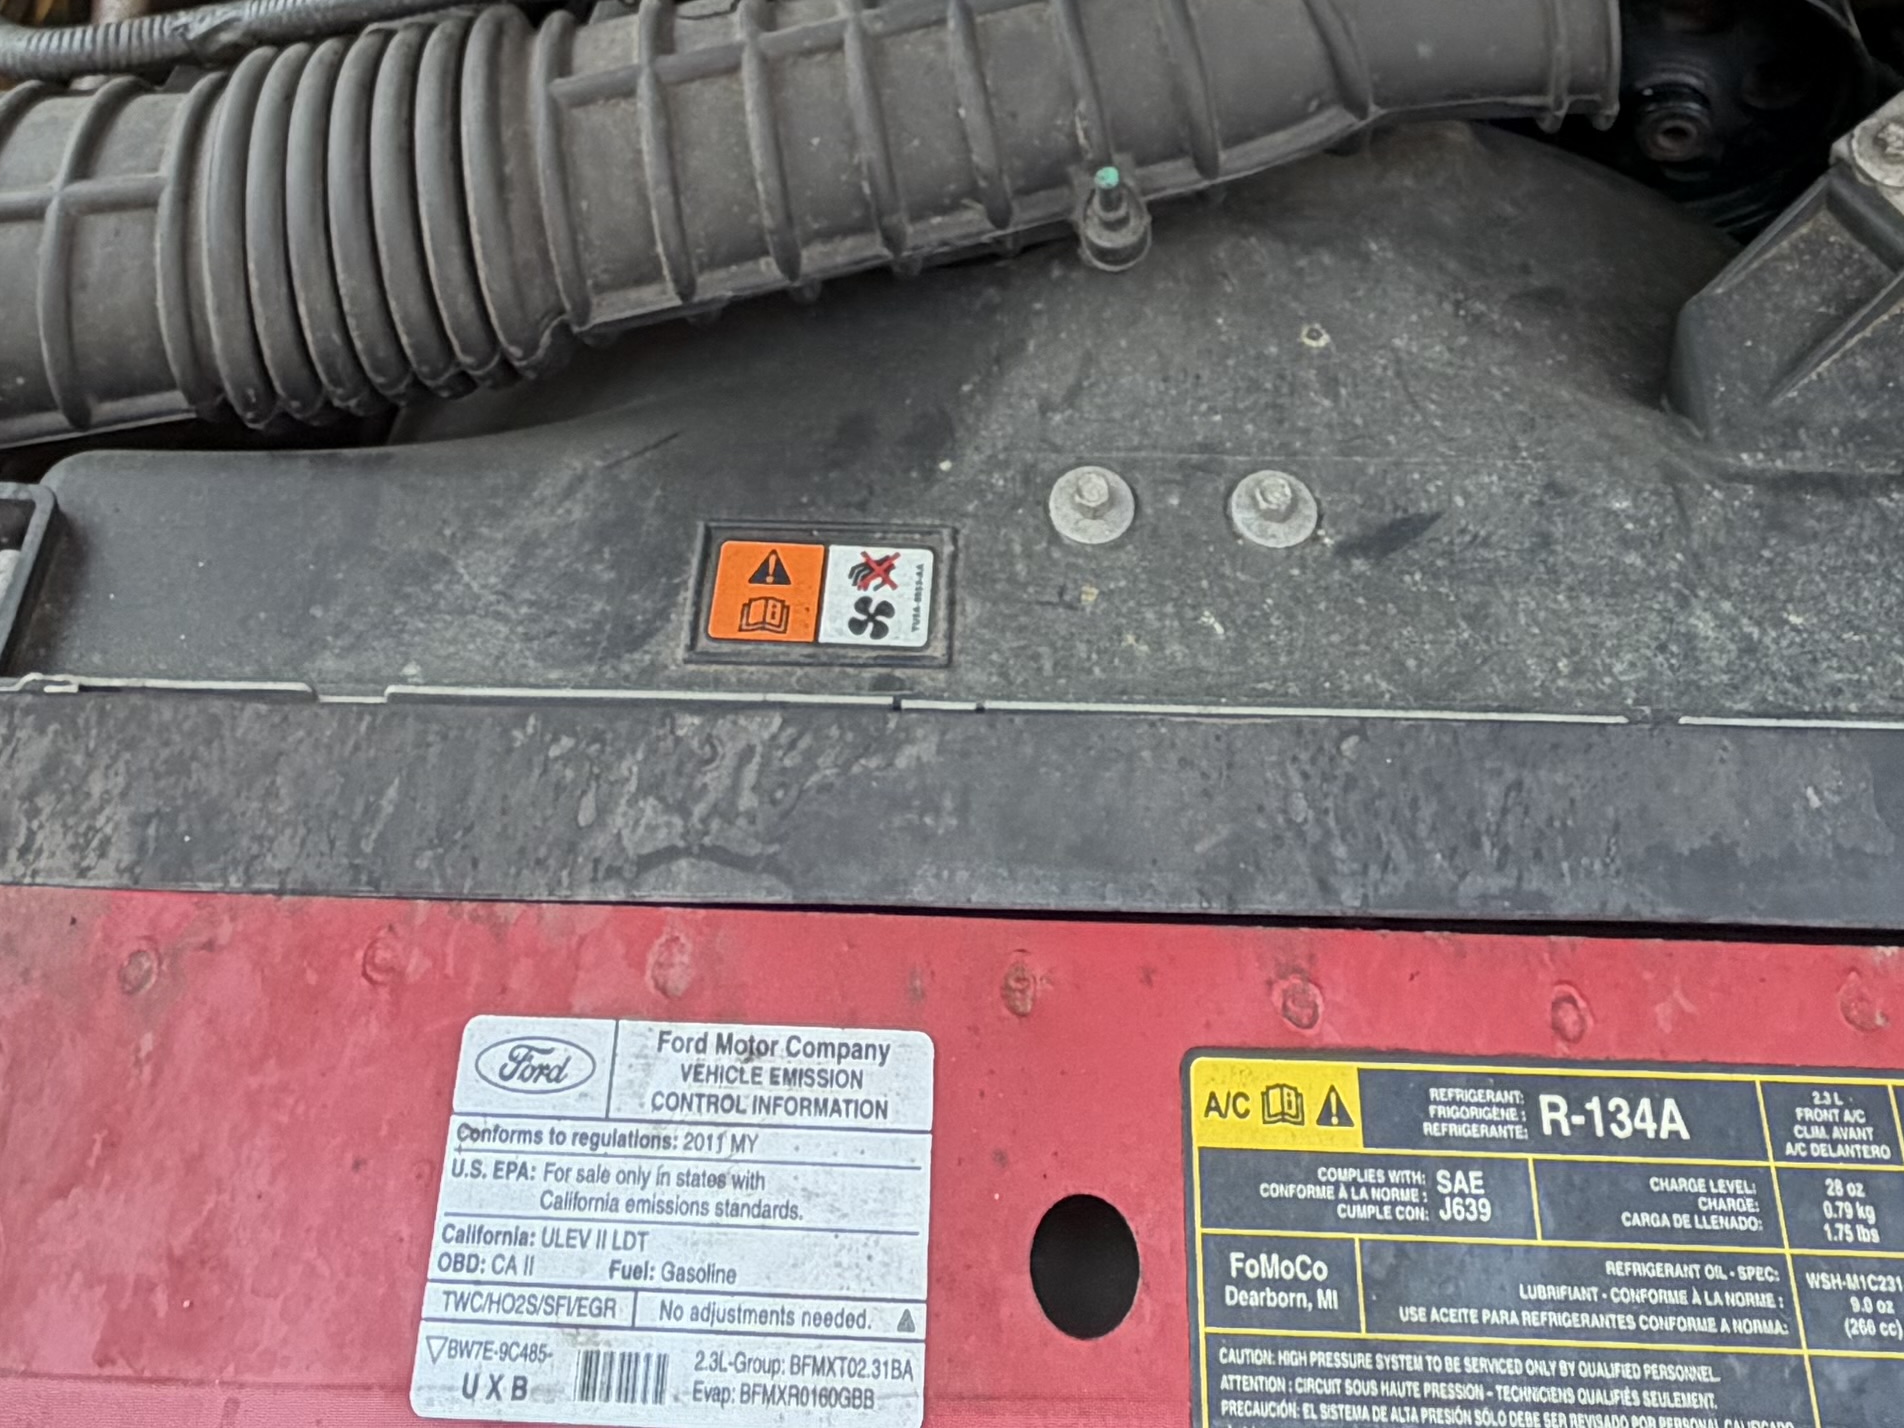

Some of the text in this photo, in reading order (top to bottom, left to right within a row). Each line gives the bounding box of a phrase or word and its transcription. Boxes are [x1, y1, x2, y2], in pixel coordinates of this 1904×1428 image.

[656, 1029, 890, 1067] Ford Motor Company
[498, 1041, 574, 1084] Ford
[680, 1062, 863, 1089] VEHICLE EMISSION
[650, 1090, 888, 1119] CONTROL INFORMATION
[1203, 1090, 1250, 1119] A/C
[1538, 1093, 1689, 1139] R-134A
[1794, 1106, 1839, 1122] FRONT
[456, 1122, 543, 1145] Conforms
[548, 1126, 567, 1146] to
[570, 1128, 678, 1150] regulations:
[729, 1132, 759, 1153] MY
[450, 1157, 487, 1179] U.S.
[492, 1159, 536, 1181] EPA:
[542, 1161, 671, 1191] For sale only in
[675, 1167, 765, 1191] states with
[1316, 1166, 1426, 1185] COMPLIES WITH:
[1435, 1168, 1485, 1194] SAE
[1259, 1182, 1335, 1200] CONFORME
[1349, 1185, 1369, 1201] LA
[1370, 1186, 1419, 1203] NORME
[1648, 1176, 1756, 1195] CHARGE LEVEL:
[1845, 1181, 1866, 1198] oz
[539, 1188, 803, 1220] California emissions standards.
[1336, 1202, 1429, 1221] CUMPLE CON:
[1438, 1195, 1491, 1222] J639
[1854, 1200, 1876, 1224] kg
[1620, 1210, 1763, 1231] CARGA DE LLENADO:
[1822, 1222, 1880, 1243] 1.75 lbs
[441, 1222, 649, 1252] California: ULEV II LDT
[436, 1250, 535, 1276] OBD: CA II
[607, 1258, 737, 1285] Fuel: Gasoline
[1229, 1251, 1328, 1281] FoMoCo
[1604, 1260, 1700, 1279] REFRIGERANT
[1224, 1284, 1338, 1311] Dearborn, MI
[1875, 1299, 1895, 1314] oz
[658, 1298, 871, 1329] No adjustments needed.
[693, 1349, 785, 1380] 2.3L-Group:
[691, 1379, 735, 1407] Evap:
